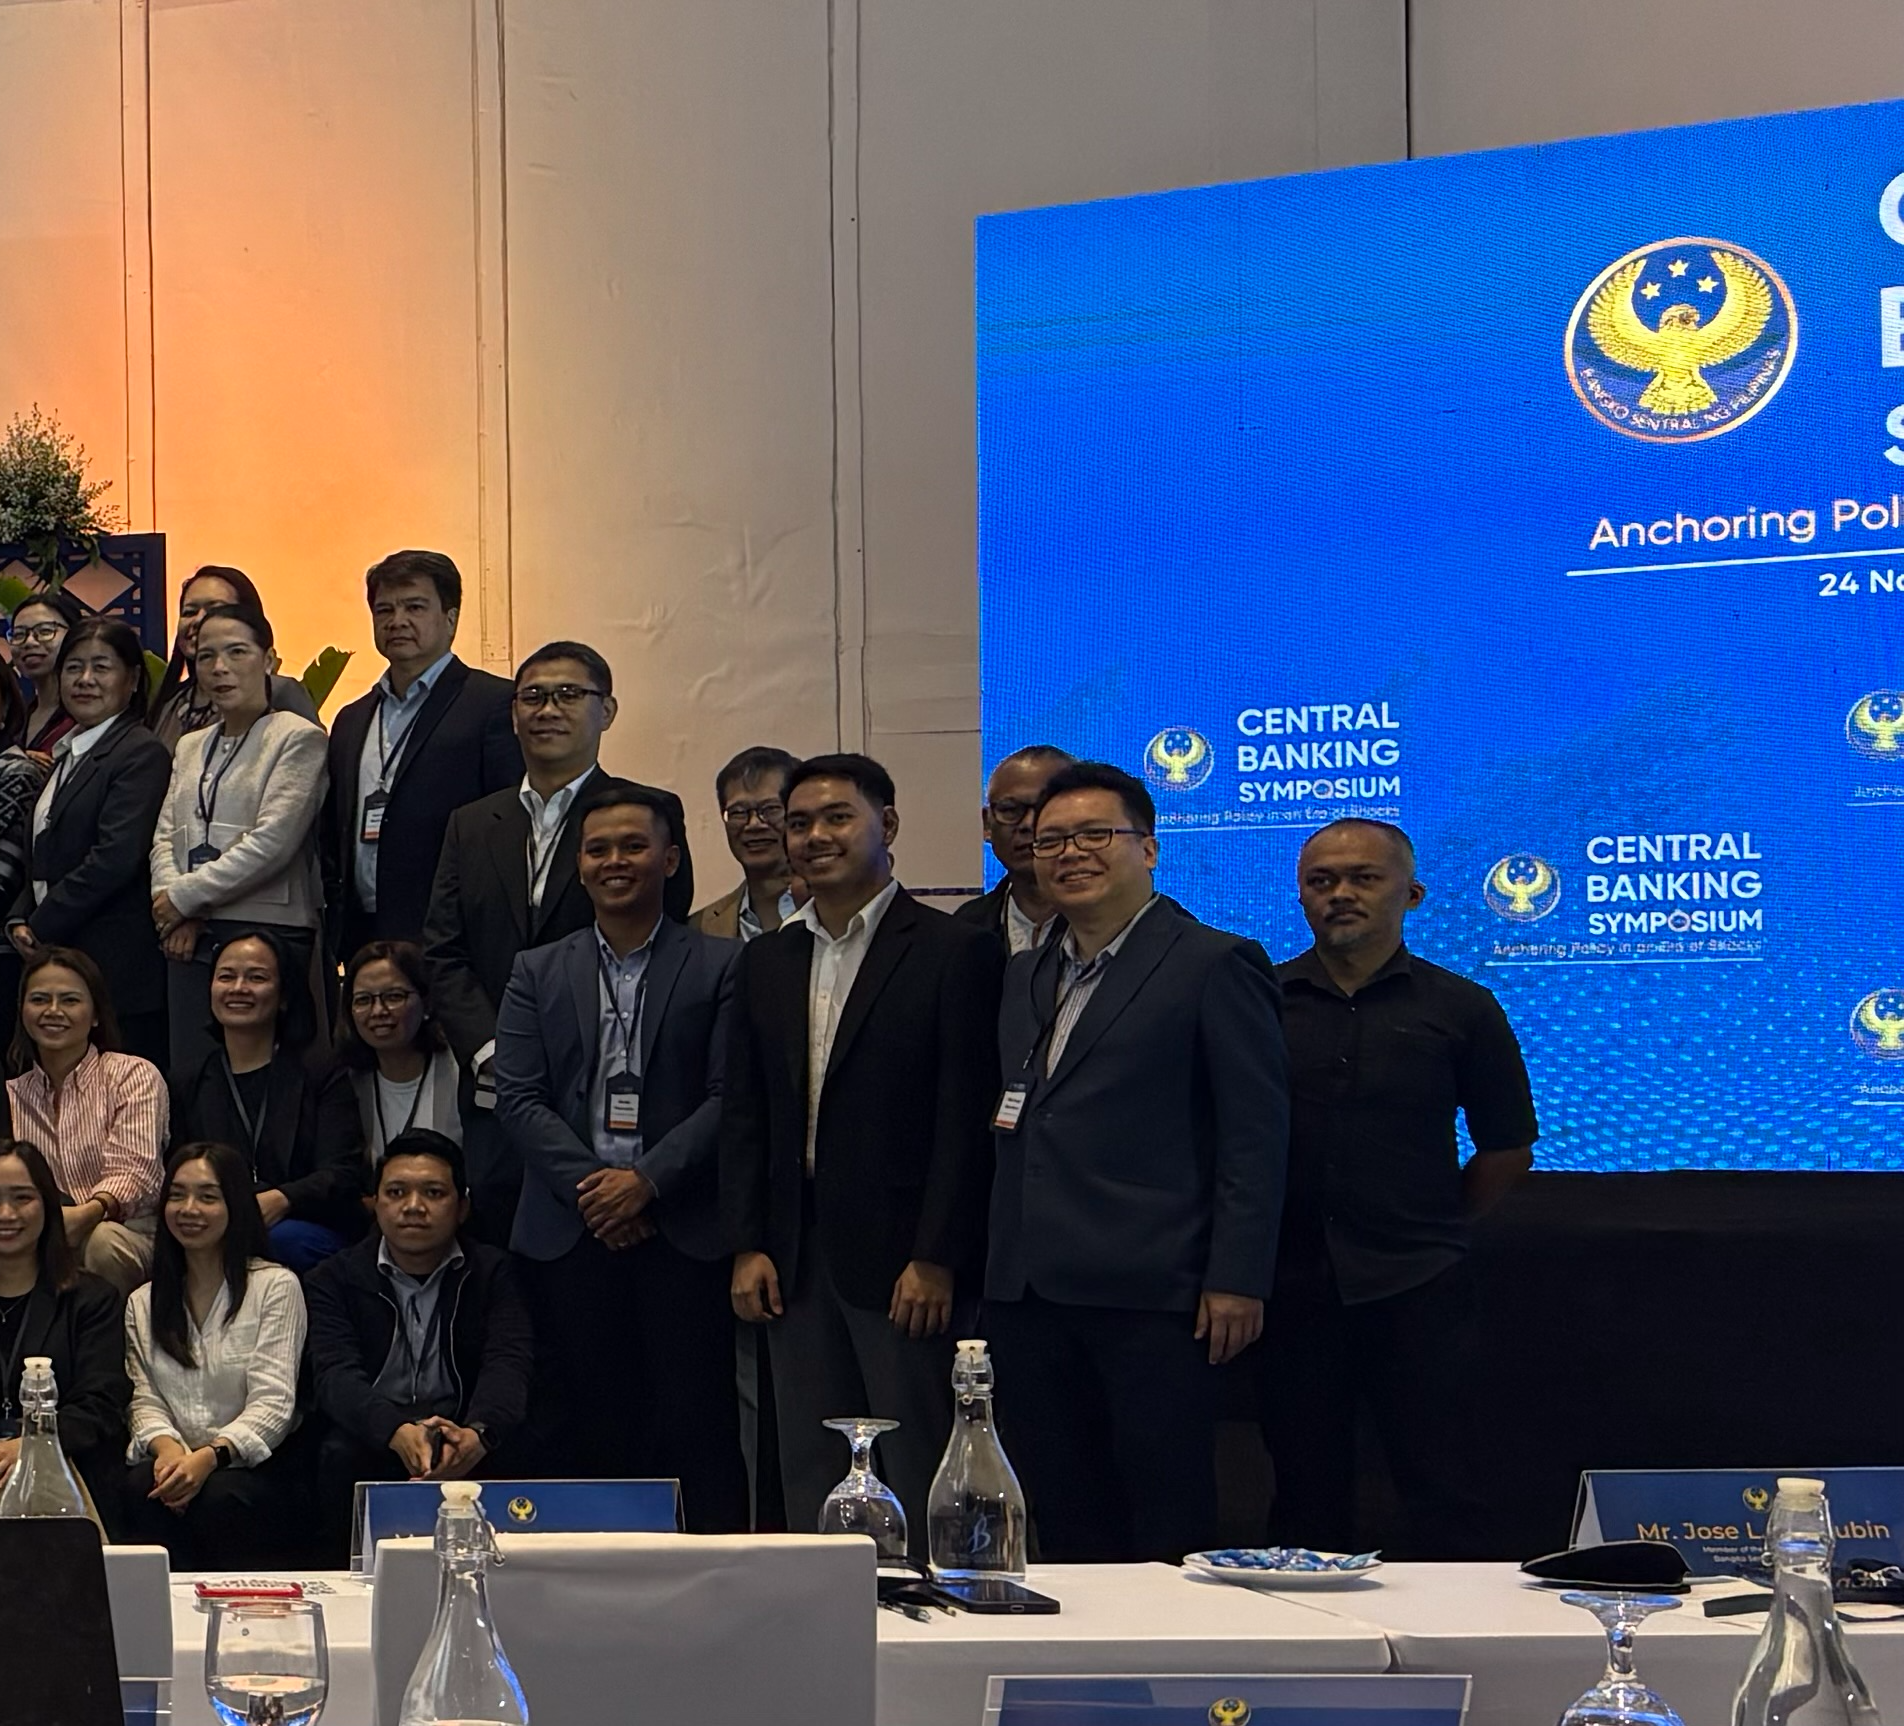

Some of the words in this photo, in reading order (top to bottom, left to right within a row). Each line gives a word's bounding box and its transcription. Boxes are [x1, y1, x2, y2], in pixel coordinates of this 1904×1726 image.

[1589, 505, 1816, 550] Anchoring
[1832, 494, 1904, 532] Pol
[1818, 571, 1860, 597] 24
[1237, 701, 1400, 736] CENTRAL
[1238, 739, 1400, 772] BANKING
[1586, 832, 1762, 864] CENTRAL
[1587, 870, 1762, 902] BANKING
[1637, 1522, 1678, 1540] Mr.
[1682, 1522, 1739, 1540] Jose
